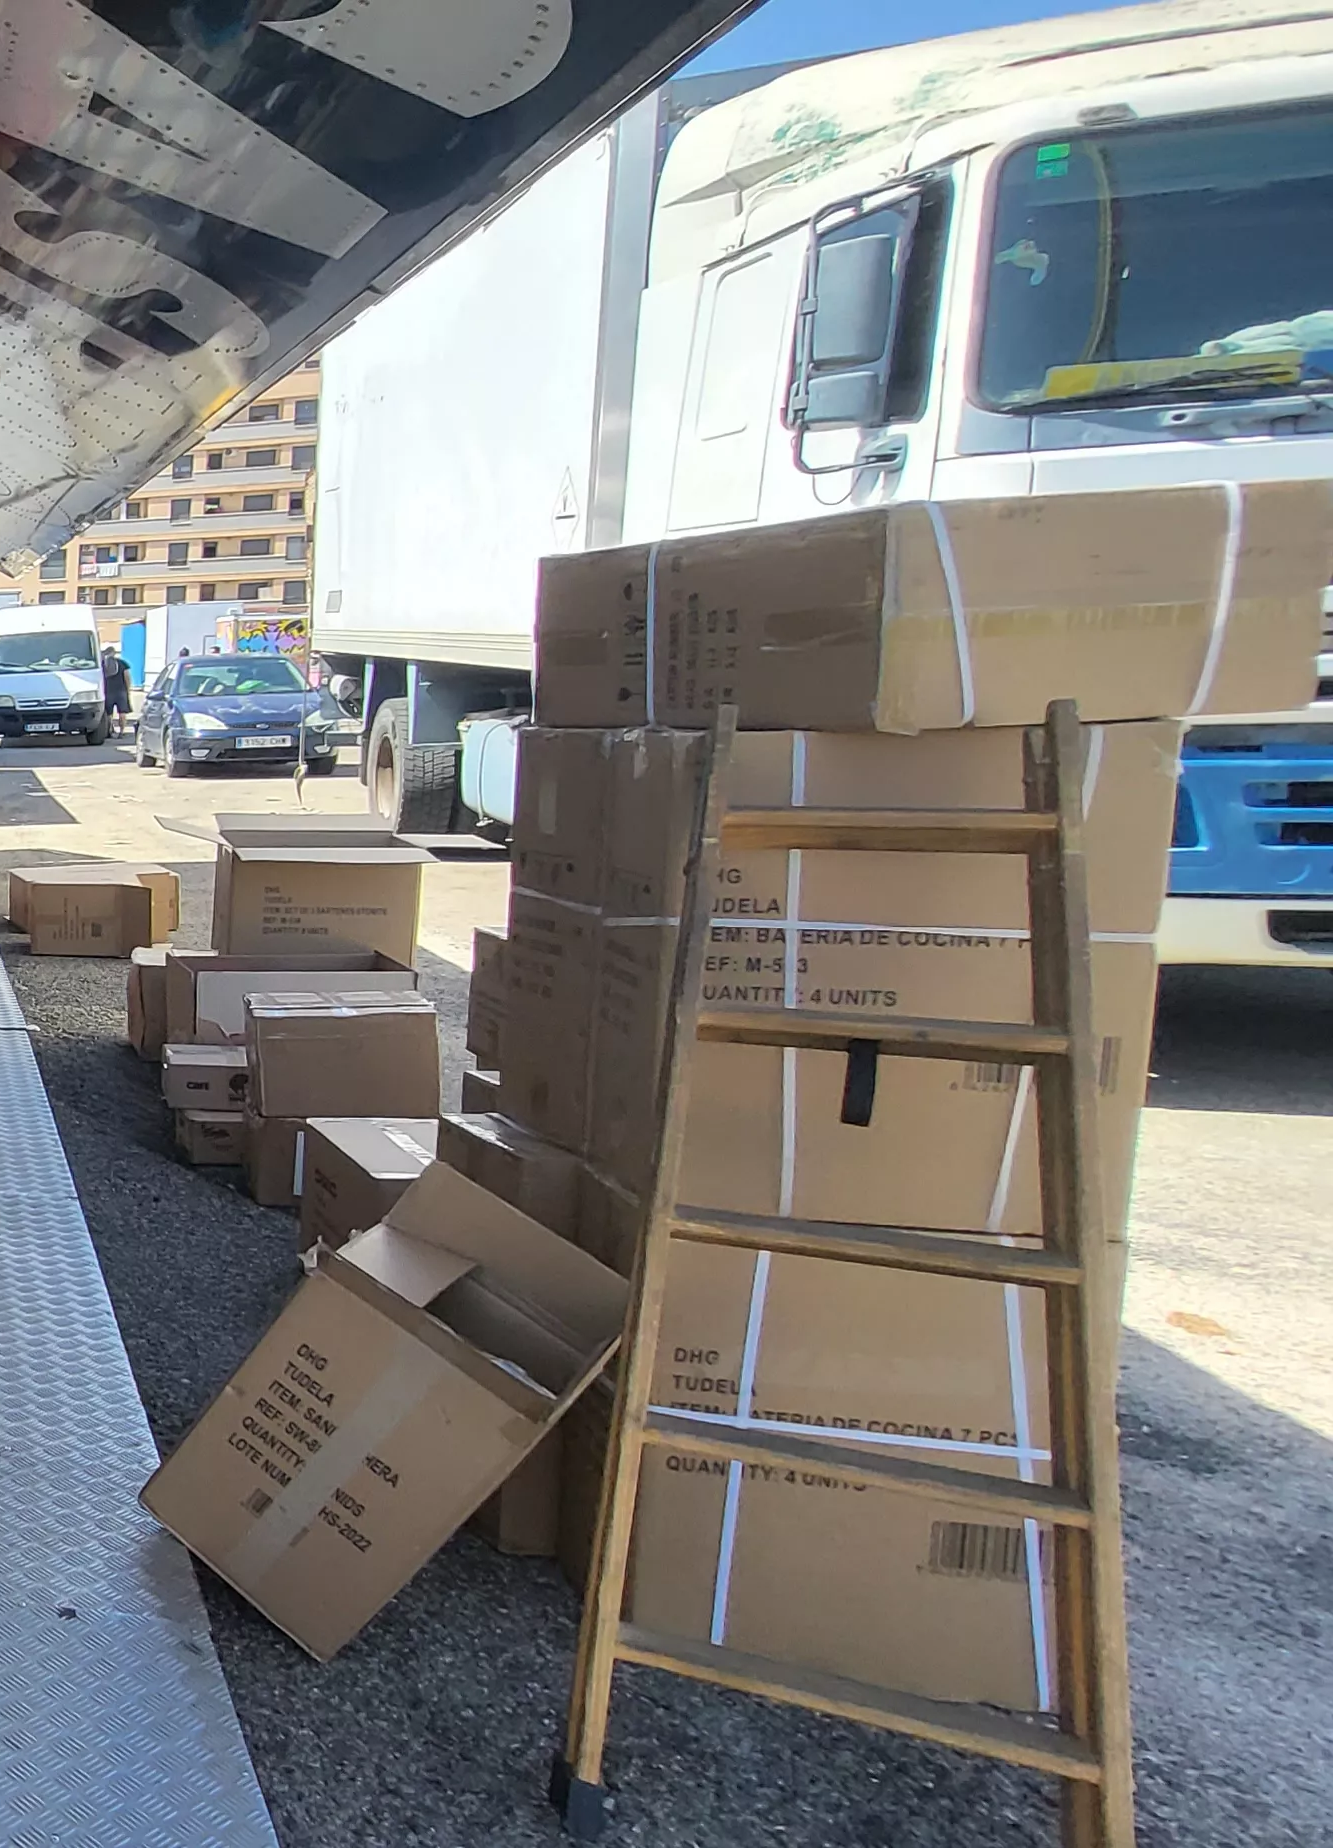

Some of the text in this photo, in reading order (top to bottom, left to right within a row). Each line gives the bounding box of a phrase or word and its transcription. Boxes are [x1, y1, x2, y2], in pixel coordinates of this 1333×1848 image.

[716, 869, 743, 884] HG
[712, 898, 780, 914] UDELA
[709, 927, 749, 943] EM:
[757, 928, 854, 946] BAERIA
[859, 930, 890, 945] DE
[705, 956, 808, 973] EF: M-53
[702, 986, 898, 1008] UANTIT: 4 UNITS
[296, 1343, 328, 1371] DHG
[674, 1347, 720, 1366] DHG
[268, 1379, 303, 1412] ITEM:
[283, 1360, 335, 1408] TUDELA
[254, 1397, 284, 1427] REF:
[734, 1408, 824, 1429] ATERIA
[228, 1432, 264, 1465] LOTE
[242, 1415, 307, 1473] QUANTITY:
[665, 1454, 776, 1483] QUANITY:
[783, 1469, 796, 1483] 4
